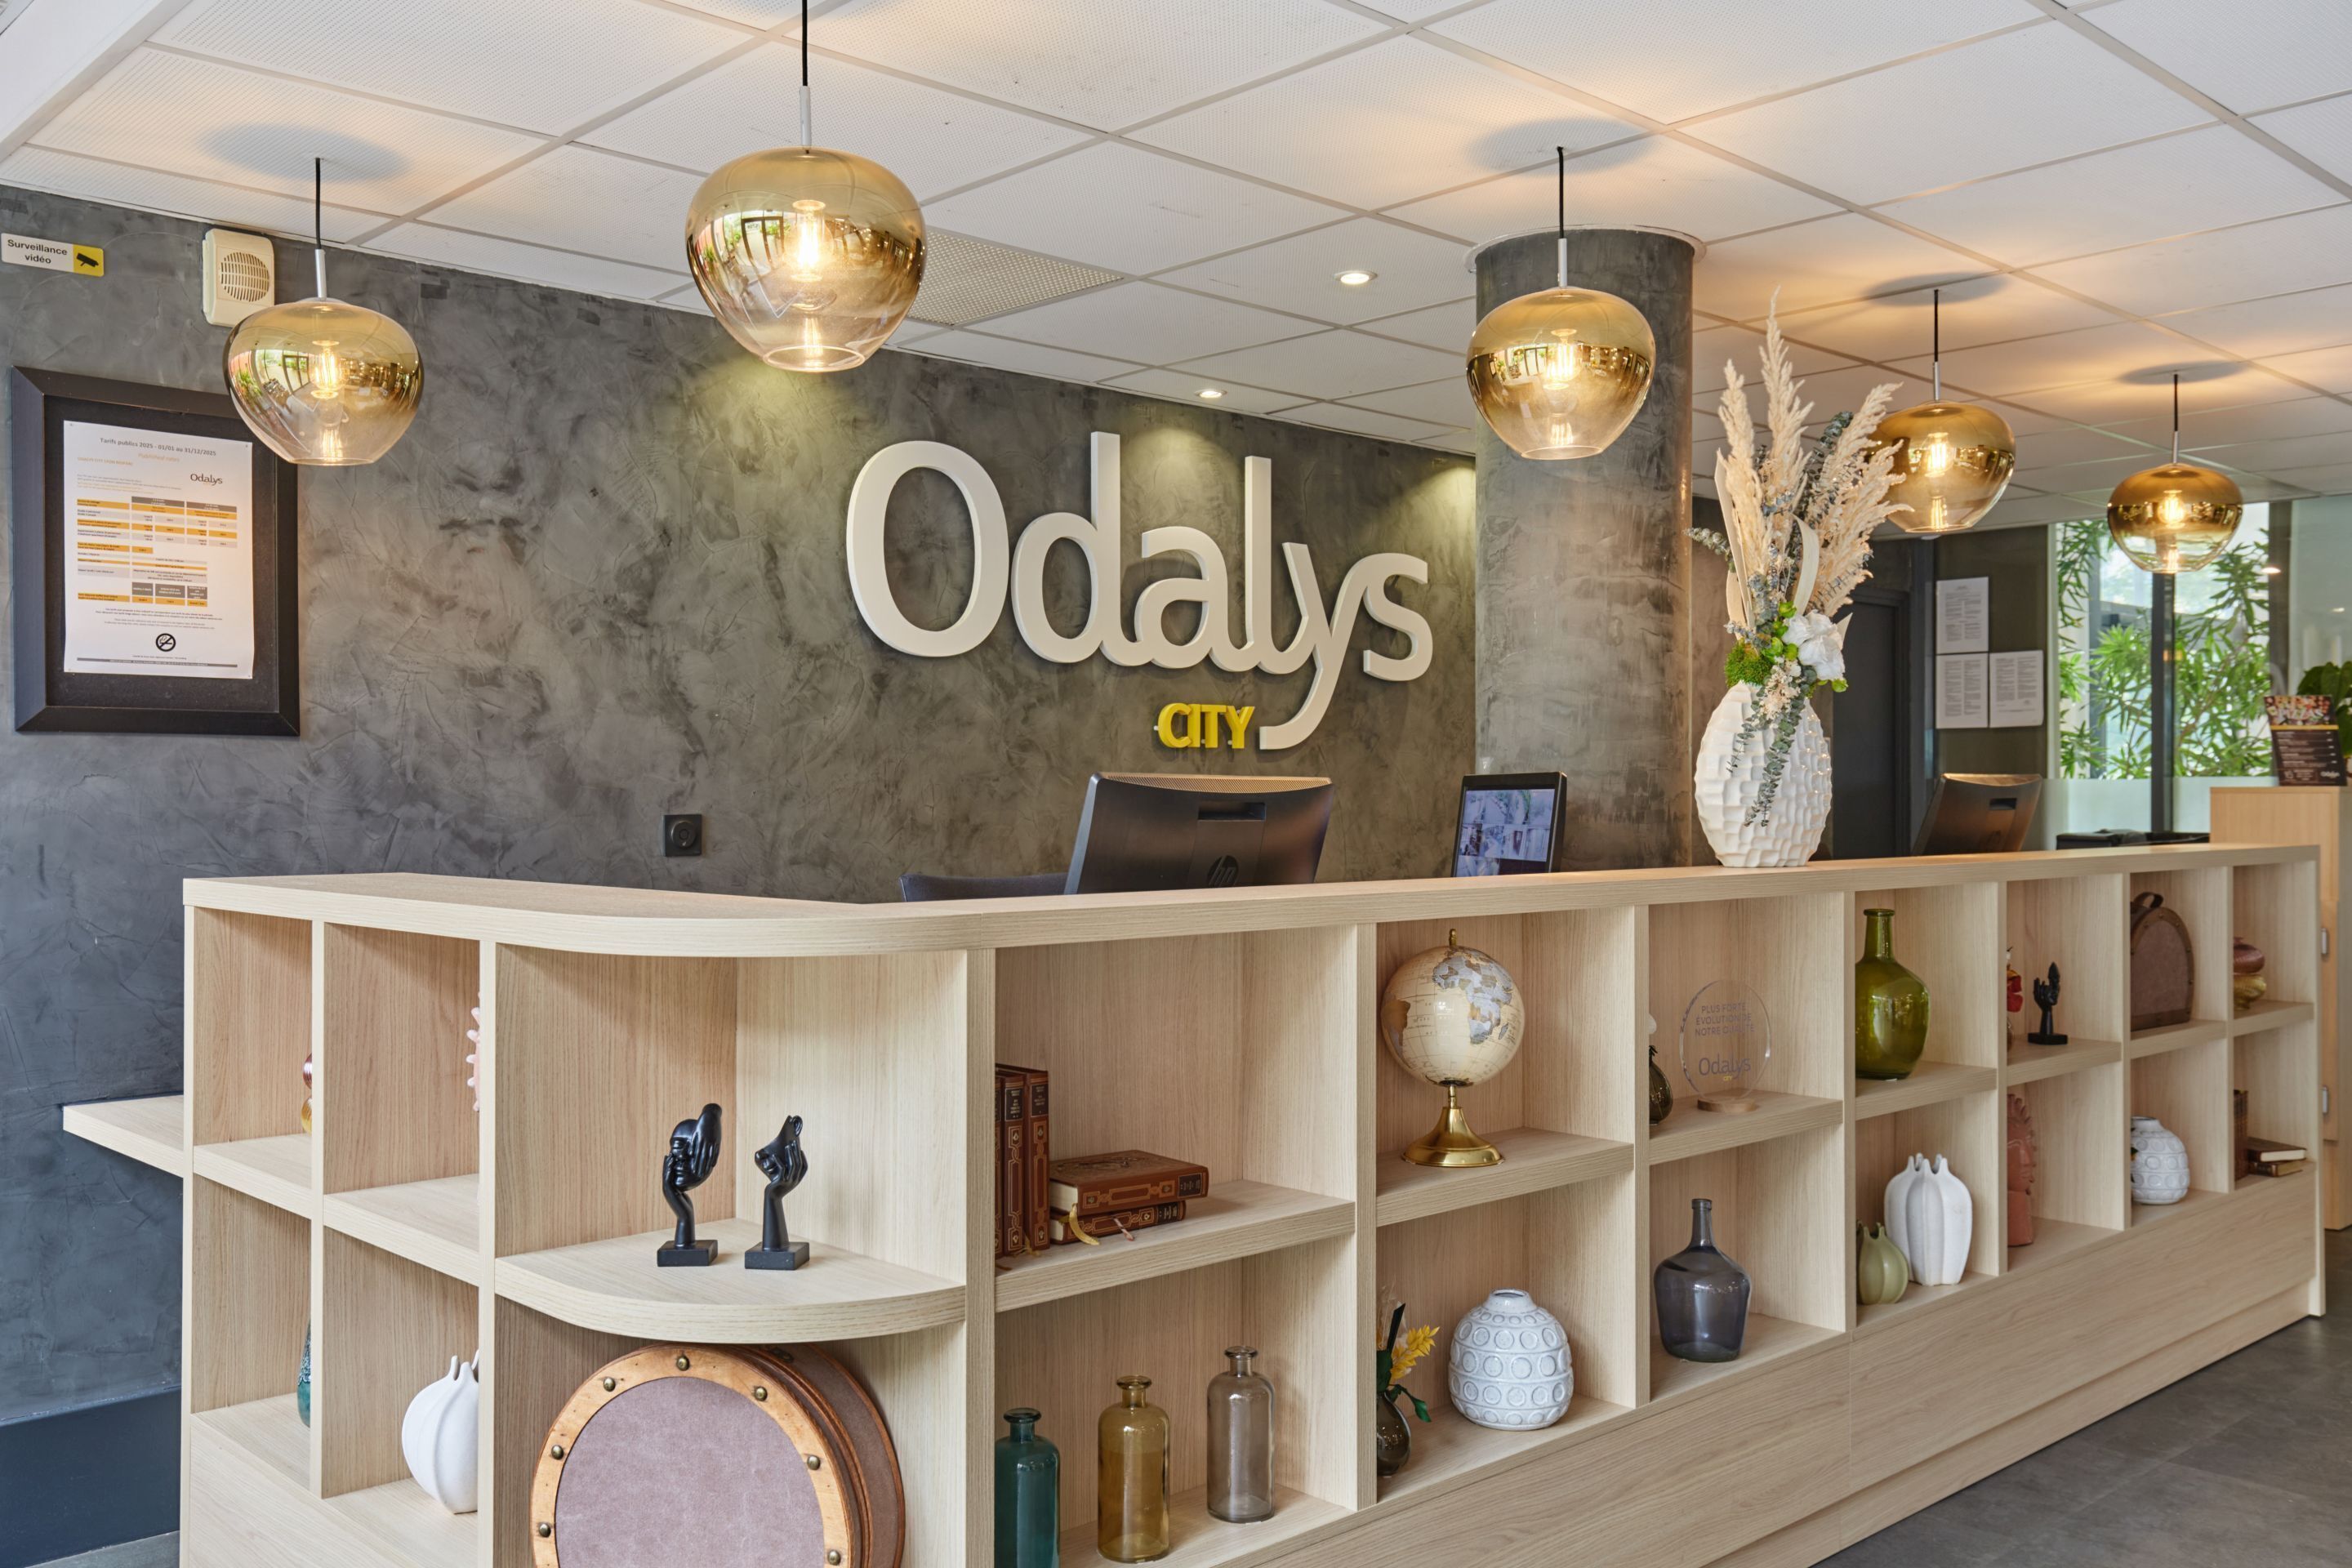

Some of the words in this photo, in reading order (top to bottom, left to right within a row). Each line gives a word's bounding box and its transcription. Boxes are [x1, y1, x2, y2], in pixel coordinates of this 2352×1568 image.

[7, 239, 68, 256] Surveillance
[24, 253, 51, 265] vidéo
[118, 439, 138, 448] publics
[185, 448, 216, 457] 31/12/2025
[190, 473, 223, 486] Odalys
[846, 431, 1434, 750] Odalys
[1157, 702, 1255, 749] CITY
[1701, 1004, 1720, 1013] PLUS
[1722, 1002, 1746, 1013] FORTE
[1741, 1013, 1752, 1022] DE
[1695, 1026, 1722, 1036] NOTRE
[1699, 1054, 1751, 1080] Odalys
